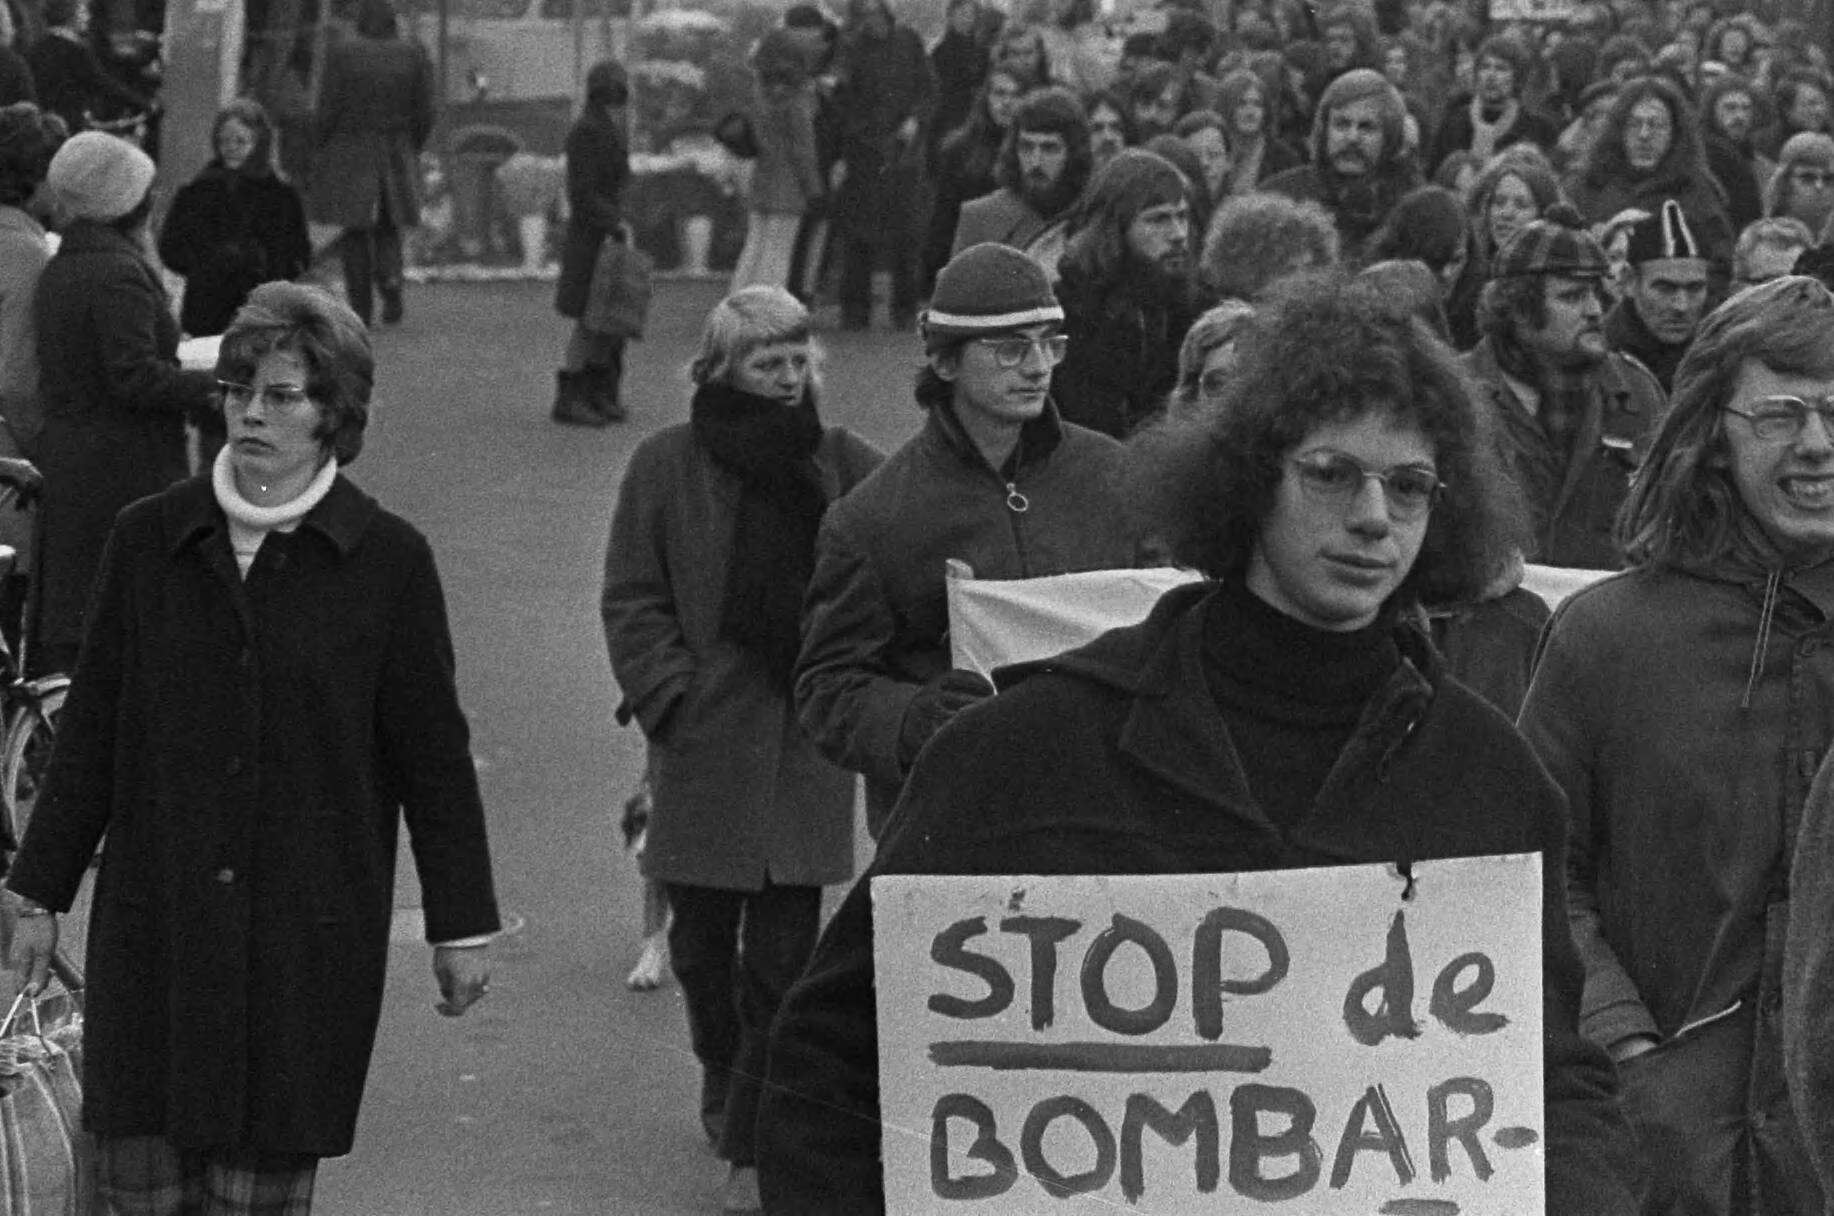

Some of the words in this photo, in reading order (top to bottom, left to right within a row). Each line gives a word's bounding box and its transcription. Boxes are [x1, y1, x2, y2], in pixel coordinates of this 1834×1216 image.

[927, 905, 1291, 1042] STOP
[1342, 907, 1512, 1047] de
[929, 1076, 1539, 1204] BOMBAR-
